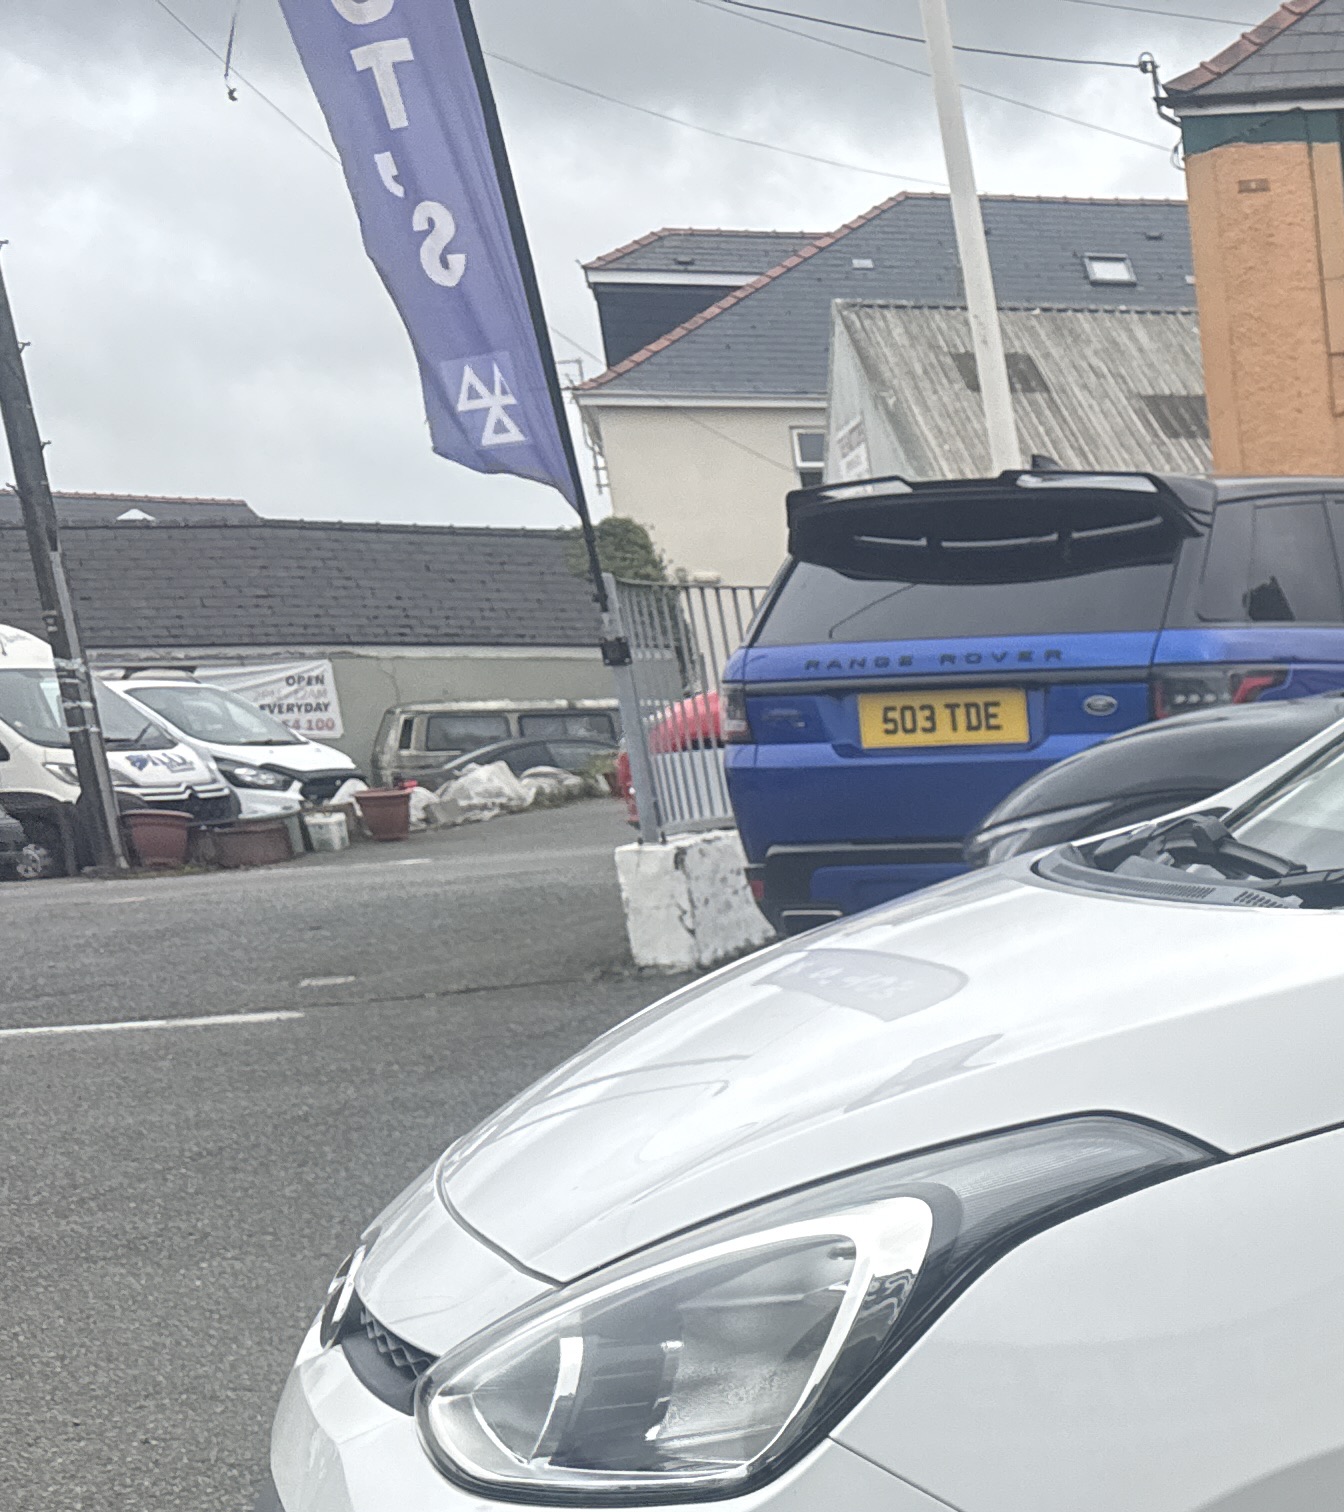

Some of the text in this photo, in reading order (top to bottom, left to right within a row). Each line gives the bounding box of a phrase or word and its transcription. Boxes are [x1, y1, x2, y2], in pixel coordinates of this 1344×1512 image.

[804, 648, 1065, 671] RANGE ROVER
[285, 674, 325, 687] OPEN
[307, 717, 335, 731] 100
[882, 701, 1003, 735] 503 TDE
